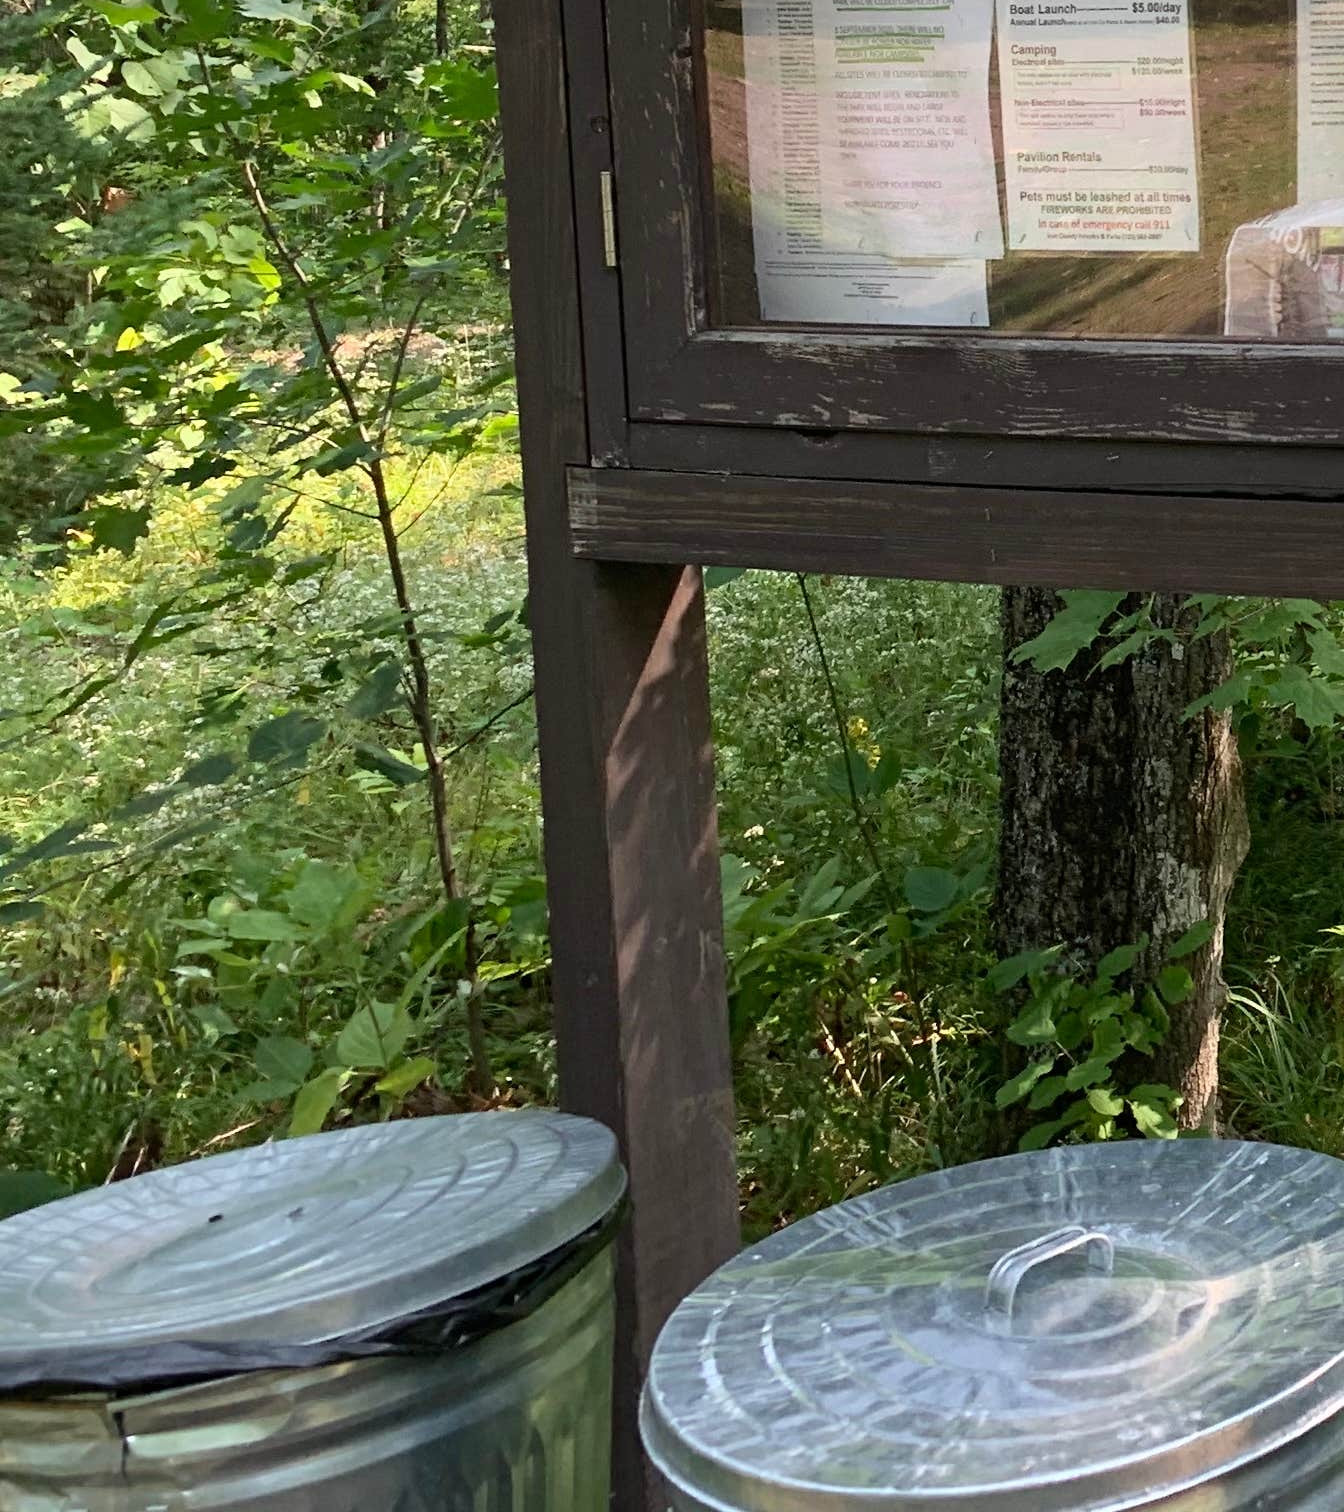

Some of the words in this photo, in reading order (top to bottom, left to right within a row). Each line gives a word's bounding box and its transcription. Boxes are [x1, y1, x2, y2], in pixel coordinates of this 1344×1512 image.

[1010, 5, 1034, 15] Boat
[1038, 4, 1077, 14] Launch
[1132, 2, 1182, 14] $5.00/day
[1010, 18, 1036, 26] Annual
[1038, 18, 1066, 26] Launch
[1011, 44, 1057, 56] Camping
[1012, 58, 1046, 66] Electrical
[1048, 58, 1065, 66] sites
[1017, 152, 1058, 162] Pavilion
[1062, 152, 1102, 162] Rentals
[1020, 192, 1042, 202] Pets
[1046, 192, 1072, 202] must
[1075, 192, 1087, 202] be
[1090, 192, 1131, 202] leashed
[1134, 192, 1144, 202] at
[1147, 192, 1160, 202] all
[1162, 192, 1192, 202] times
[1041, 204, 1093, 214] FIREWORKS
[1096, 205, 1114, 214] ARE
[1116, 205, 1172, 214] PROHIBITED
[1038, 219, 1046, 228] In
[1048, 220, 1068, 229] case
[1070, 219, 1080, 228] of
[1082, 220, 1132, 231] emergency
[1134, 220, 1150, 230] call
[1152, 220, 1170, 230] 911
